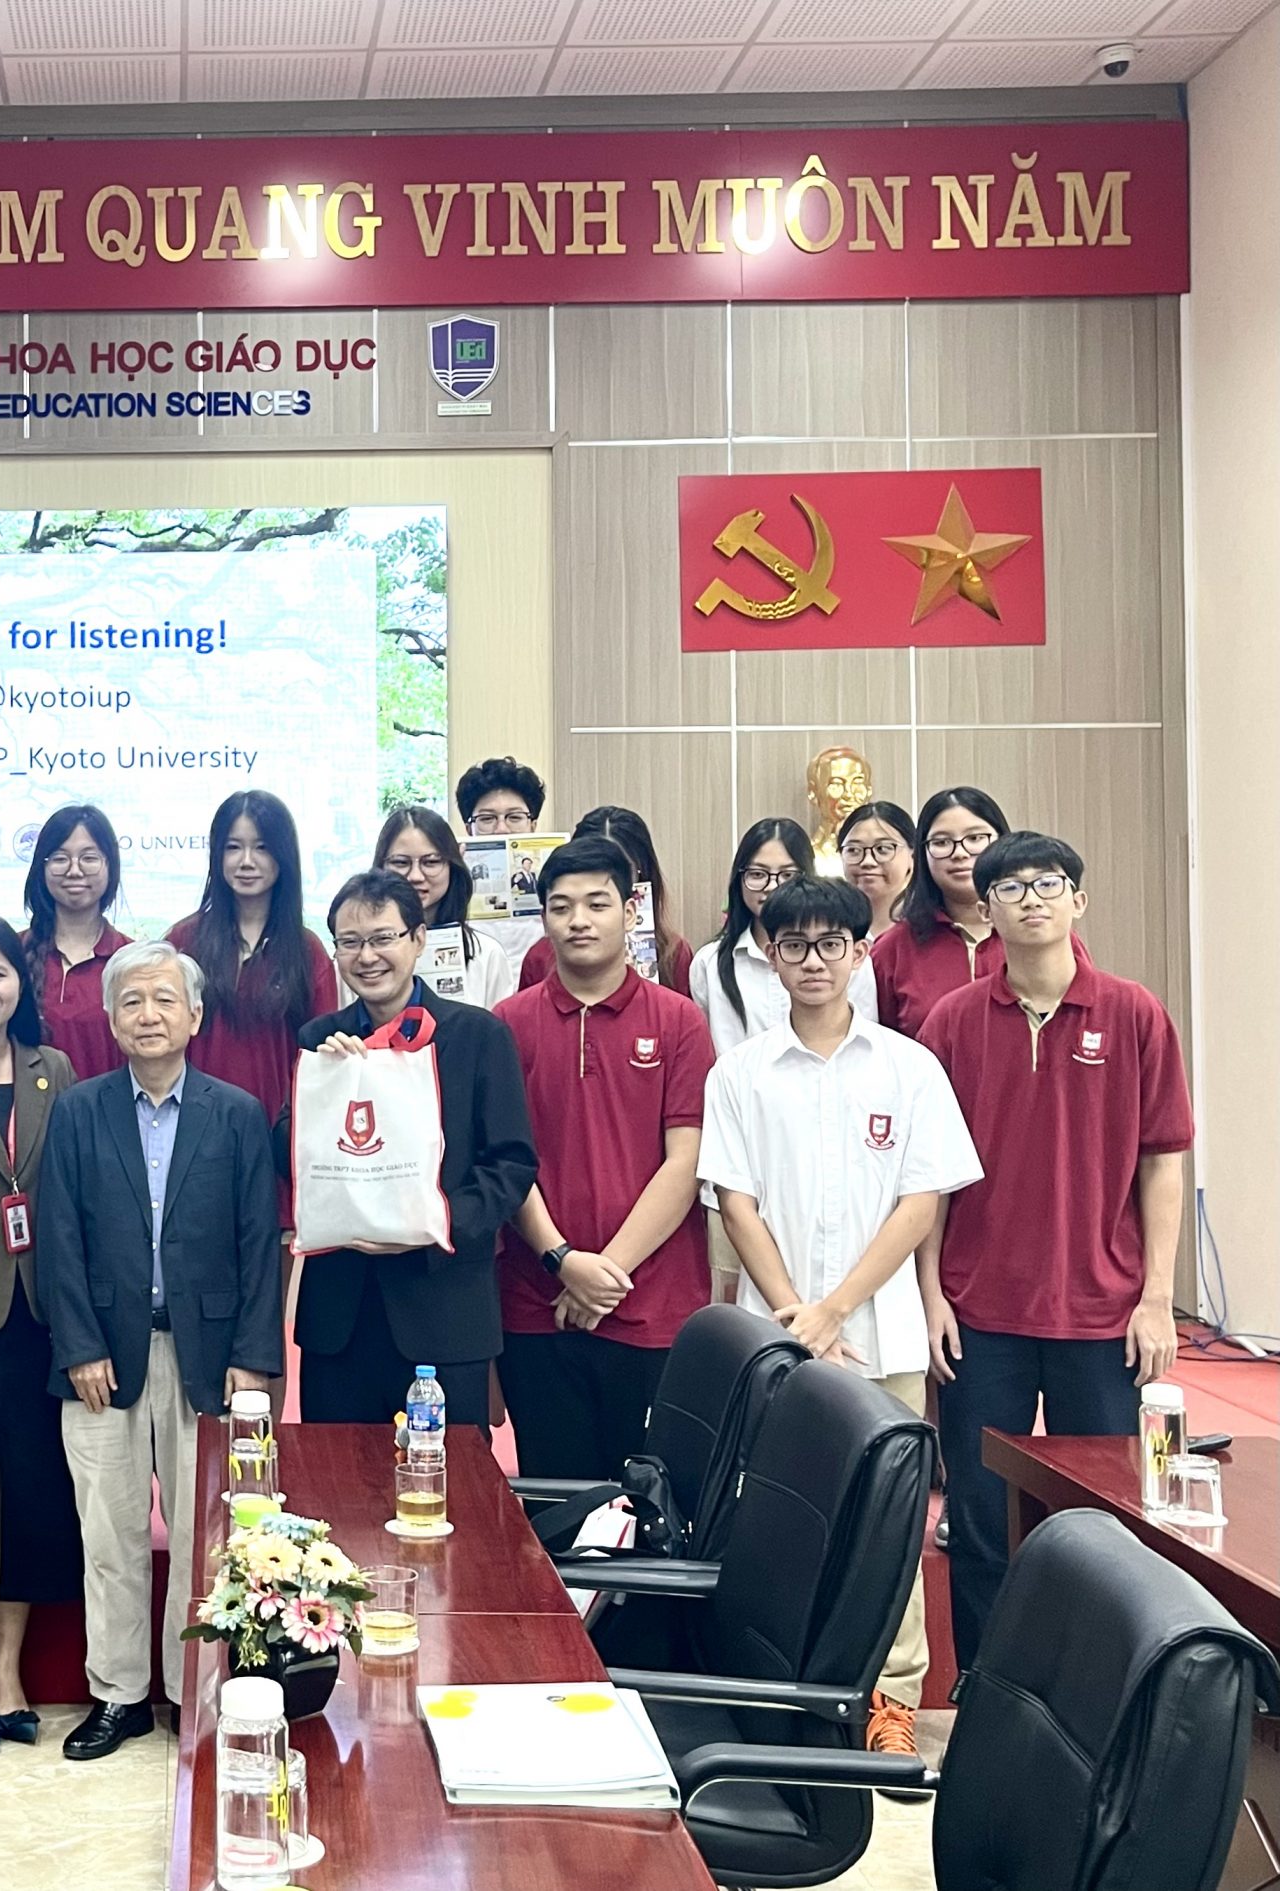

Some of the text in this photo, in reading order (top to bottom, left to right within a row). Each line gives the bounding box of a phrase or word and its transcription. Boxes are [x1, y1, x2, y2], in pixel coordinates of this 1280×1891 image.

[85, 181, 383, 269] QUANG
[402, 180, 627, 258] VINH
[650, 153, 911, 256] MUÔN
[930, 151, 1132, 251] NĂM
[89, 341, 175, 382] HỌC
[184, 333, 282, 374] GIÁO
[295, 338, 377, 380] DỤC
[165, 390, 312, 417] SCIENCES
[8, 621, 58, 650] for
[69, 619, 228, 655] listening!
[117, 744, 259, 774] University
